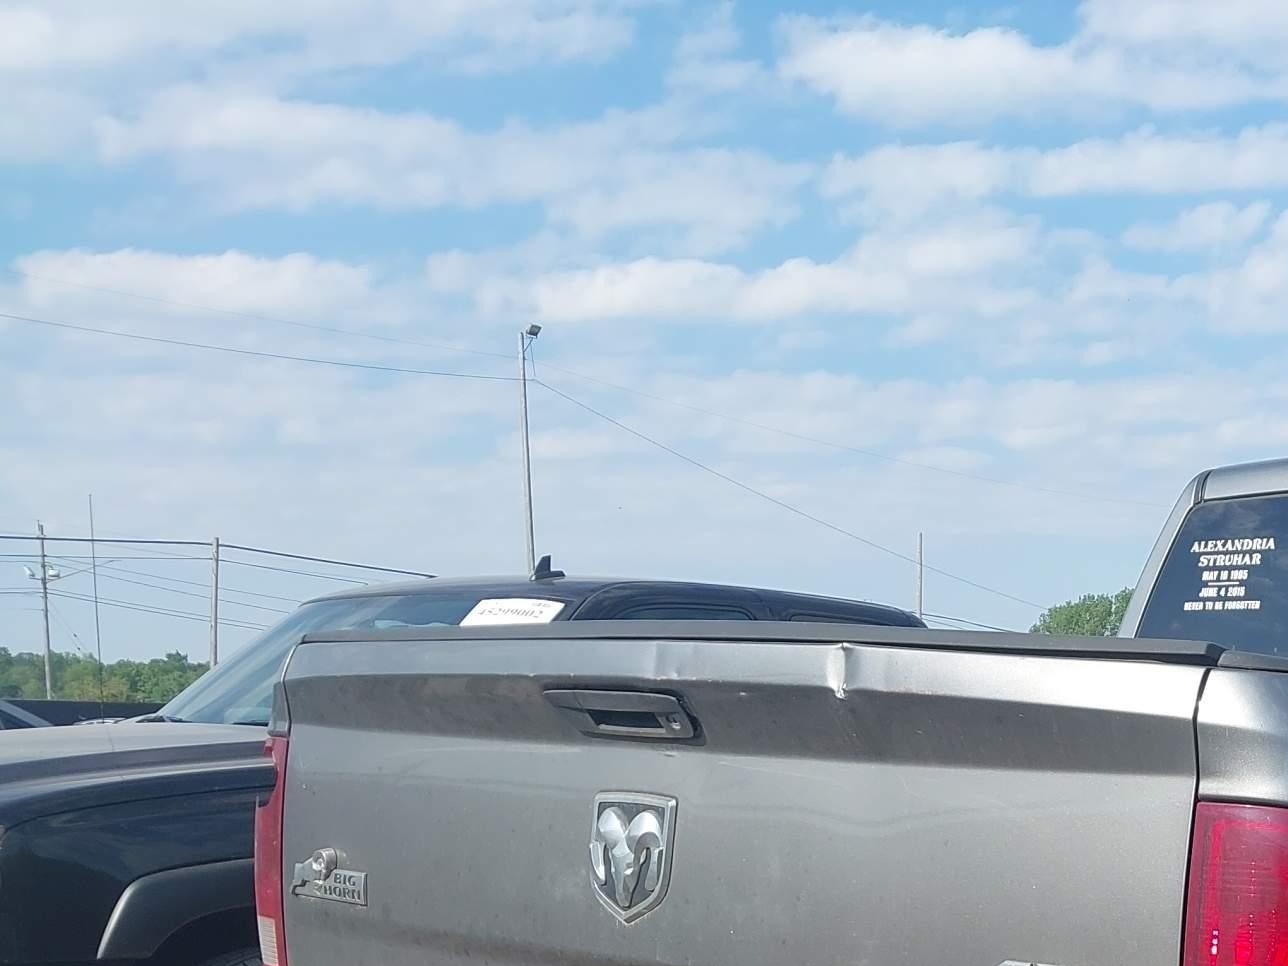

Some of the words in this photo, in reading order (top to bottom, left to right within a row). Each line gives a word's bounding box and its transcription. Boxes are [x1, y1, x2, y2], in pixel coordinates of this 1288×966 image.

[1190, 537, 1275, 553] ALEXANDRIA
[1198, 553, 1262, 567] STRUHAR
[1201, 570, 1219, 581] MAY
[1198, 587, 1218, 597] JUNE
[1219, 587, 1226, 597] 4
[1226, 586, 1246, 597] 2015
[1183, 601, 1204, 611] NEVER
[1205, 601, 1214, 610] TO
[1214, 601, 1223, 610] BE
[1223, 600, 1261, 610] FORGOTTEN
[333, 872, 356, 887] BIG
[324, 884, 361, 901] HORN
